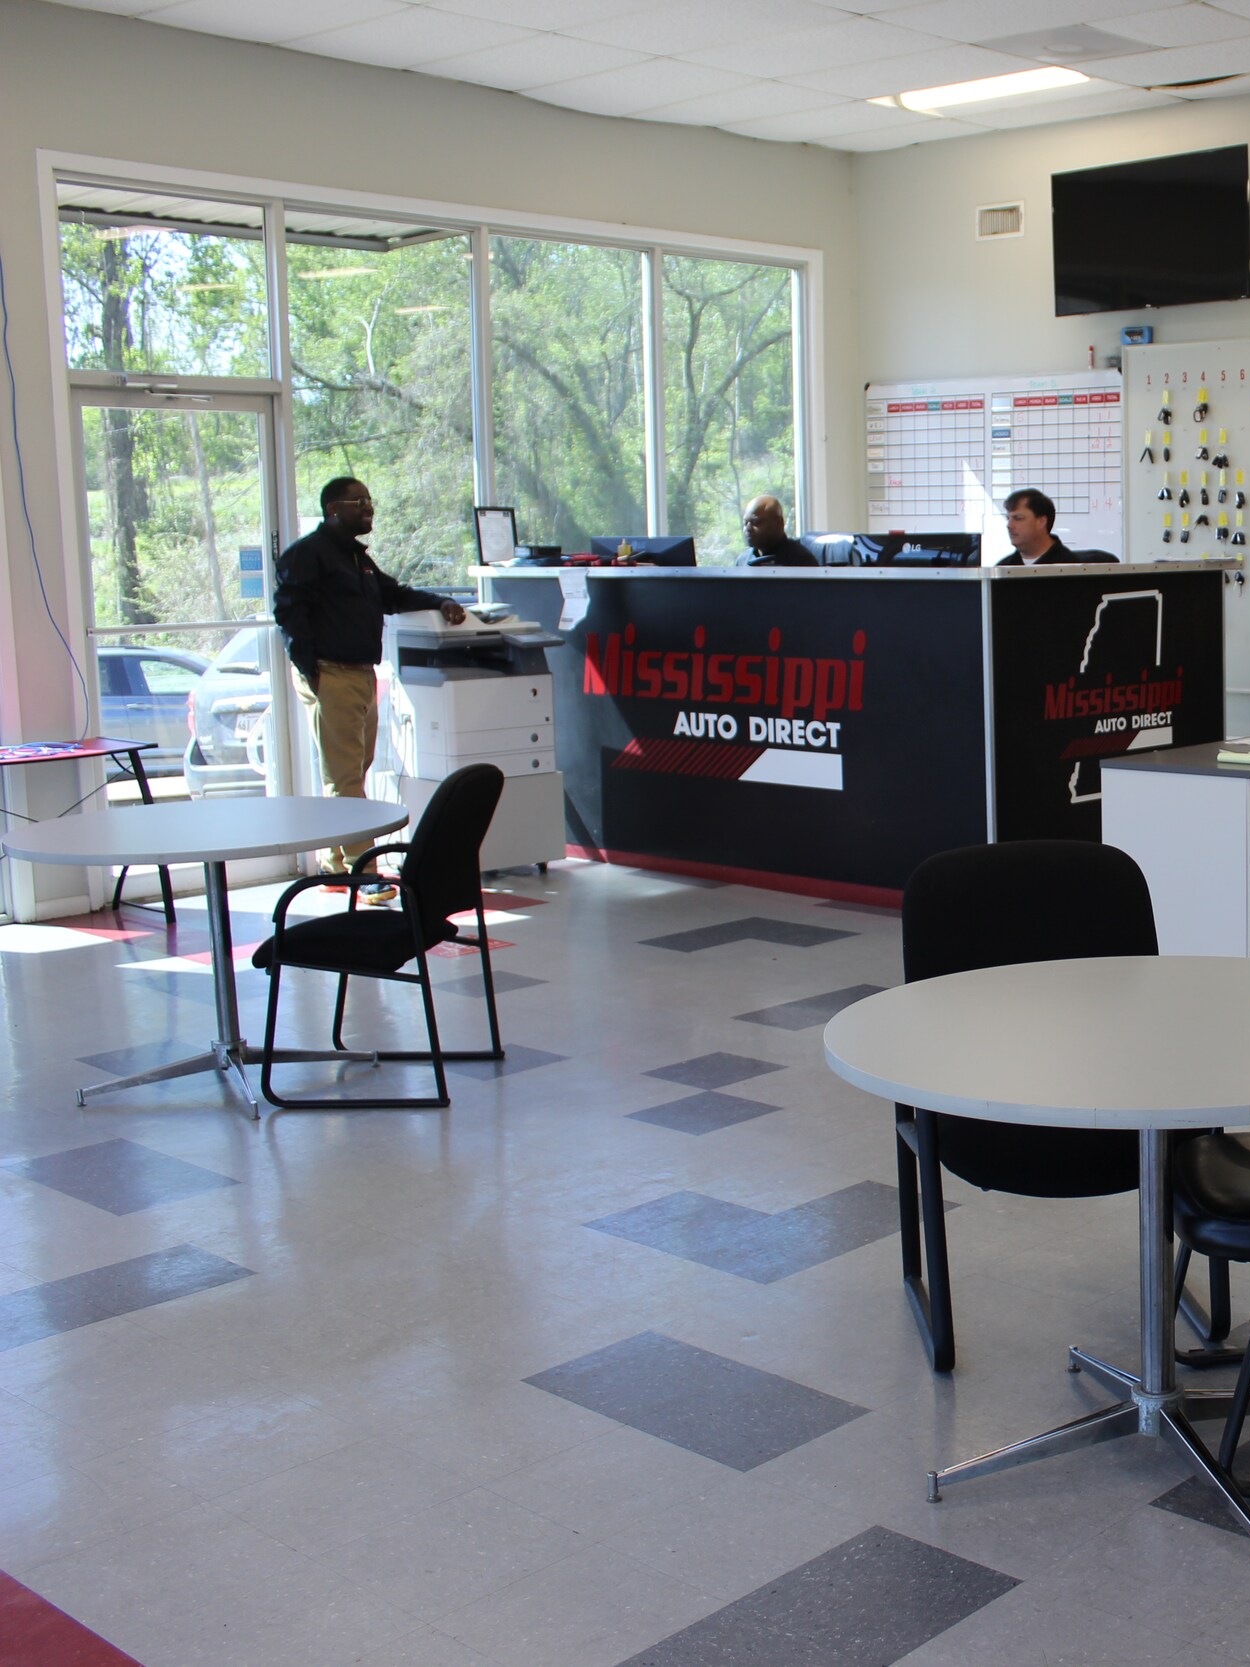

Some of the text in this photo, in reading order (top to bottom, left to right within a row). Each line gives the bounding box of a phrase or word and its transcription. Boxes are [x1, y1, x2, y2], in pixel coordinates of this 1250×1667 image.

[1147, 375, 1151, 385] 1
[1164, 373, 1169, 384] 2
[1182, 372, 1187, 383] 3
[1201, 371, 1206, 382] 4
[1221, 370, 1226, 381] 5
[1240, 369, 1245, 380] 6
[583, 623, 867, 722] Mississippi
[1044, 665, 1184, 720] Mississippi
[673, 711, 841, 748] AUTO DIRECT
[1094, 711, 1173, 734] AUTO DIRECT
